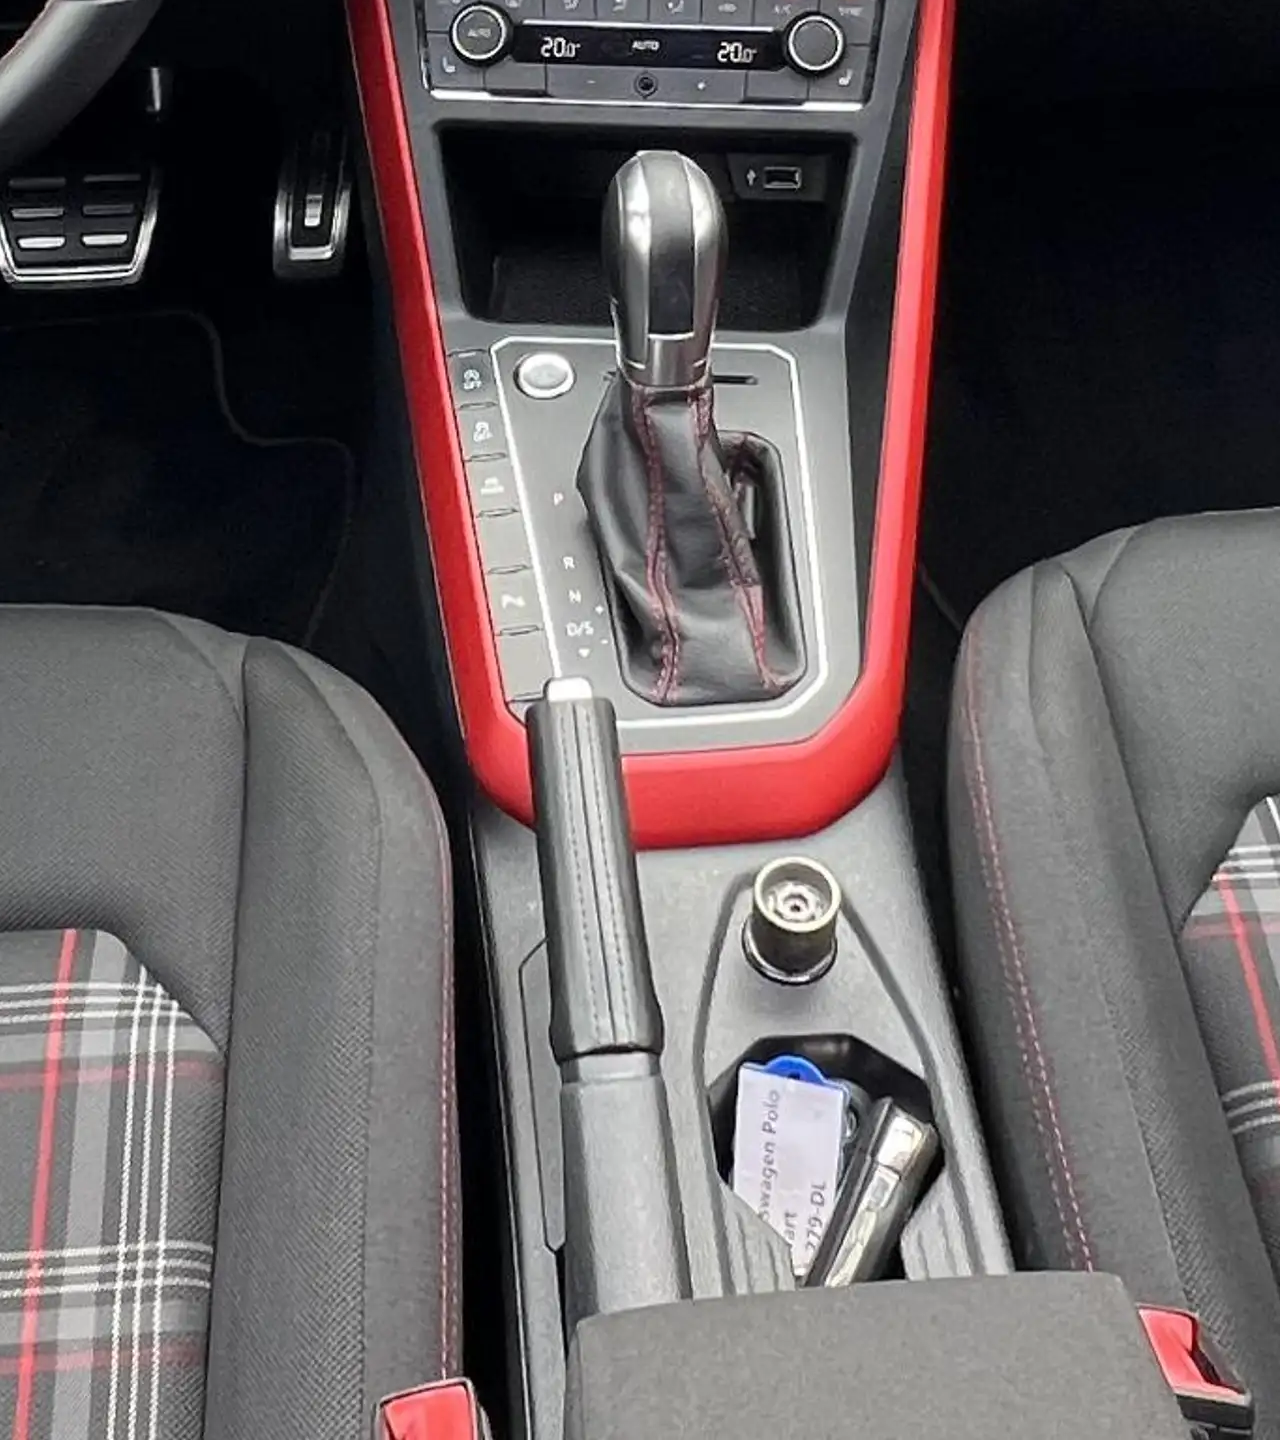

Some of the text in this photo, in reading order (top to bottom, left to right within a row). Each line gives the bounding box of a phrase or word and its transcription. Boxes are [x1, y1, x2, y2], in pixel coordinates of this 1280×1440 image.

[553, 492, 565, 506] P
[562, 556, 576, 571] R
[568, 589, 582, 604] N
[758, 1089, 782, 1223] swagen Polo
[783, 1211, 798, 1242] art
